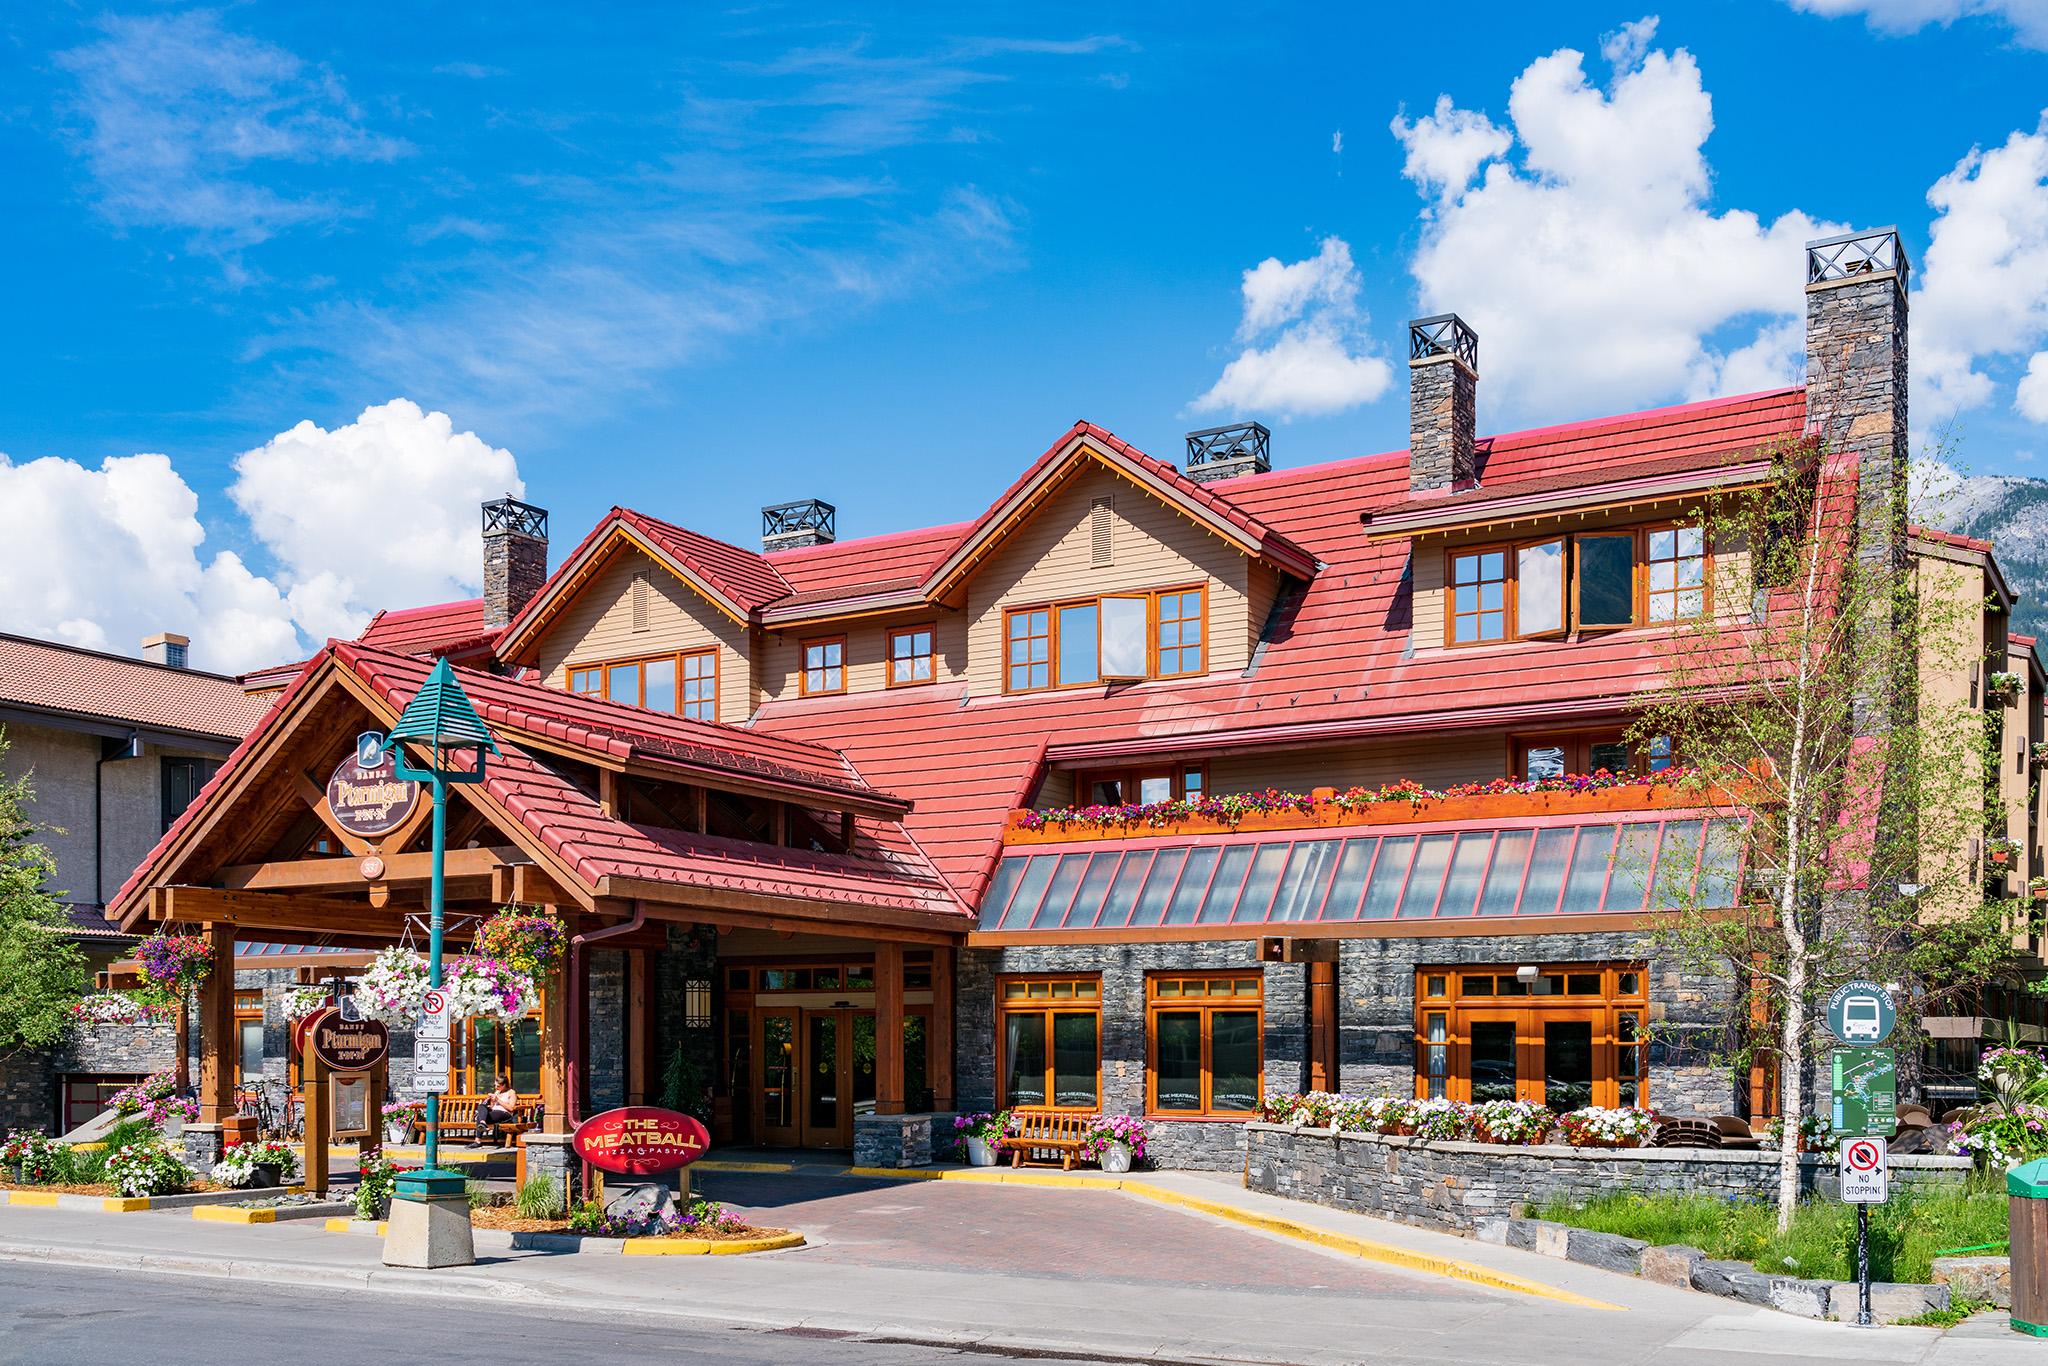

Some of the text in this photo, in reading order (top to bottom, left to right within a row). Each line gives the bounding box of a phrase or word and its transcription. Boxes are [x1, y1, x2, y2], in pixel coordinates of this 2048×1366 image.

[356, 770, 387, 780] BANFF
[336, 779, 409, 812] Ptarmigan
[1830, 982, 1894, 1011] PUBLIC TRANSIT STOP
[322, 1028, 382, 1053] Ptarmigan
[421, 1044, 430, 1052] 15
[1226, 1093, 1257, 1101] MEATBALL
[623, 1119, 659, 1130] THE
[583, 1131, 702, 1151] MEATBALL
[598, 1147, 633, 1157] PIZZA
[649, 1147, 685, 1156] PASTA
[1858, 1174, 1870, 1183] NO
